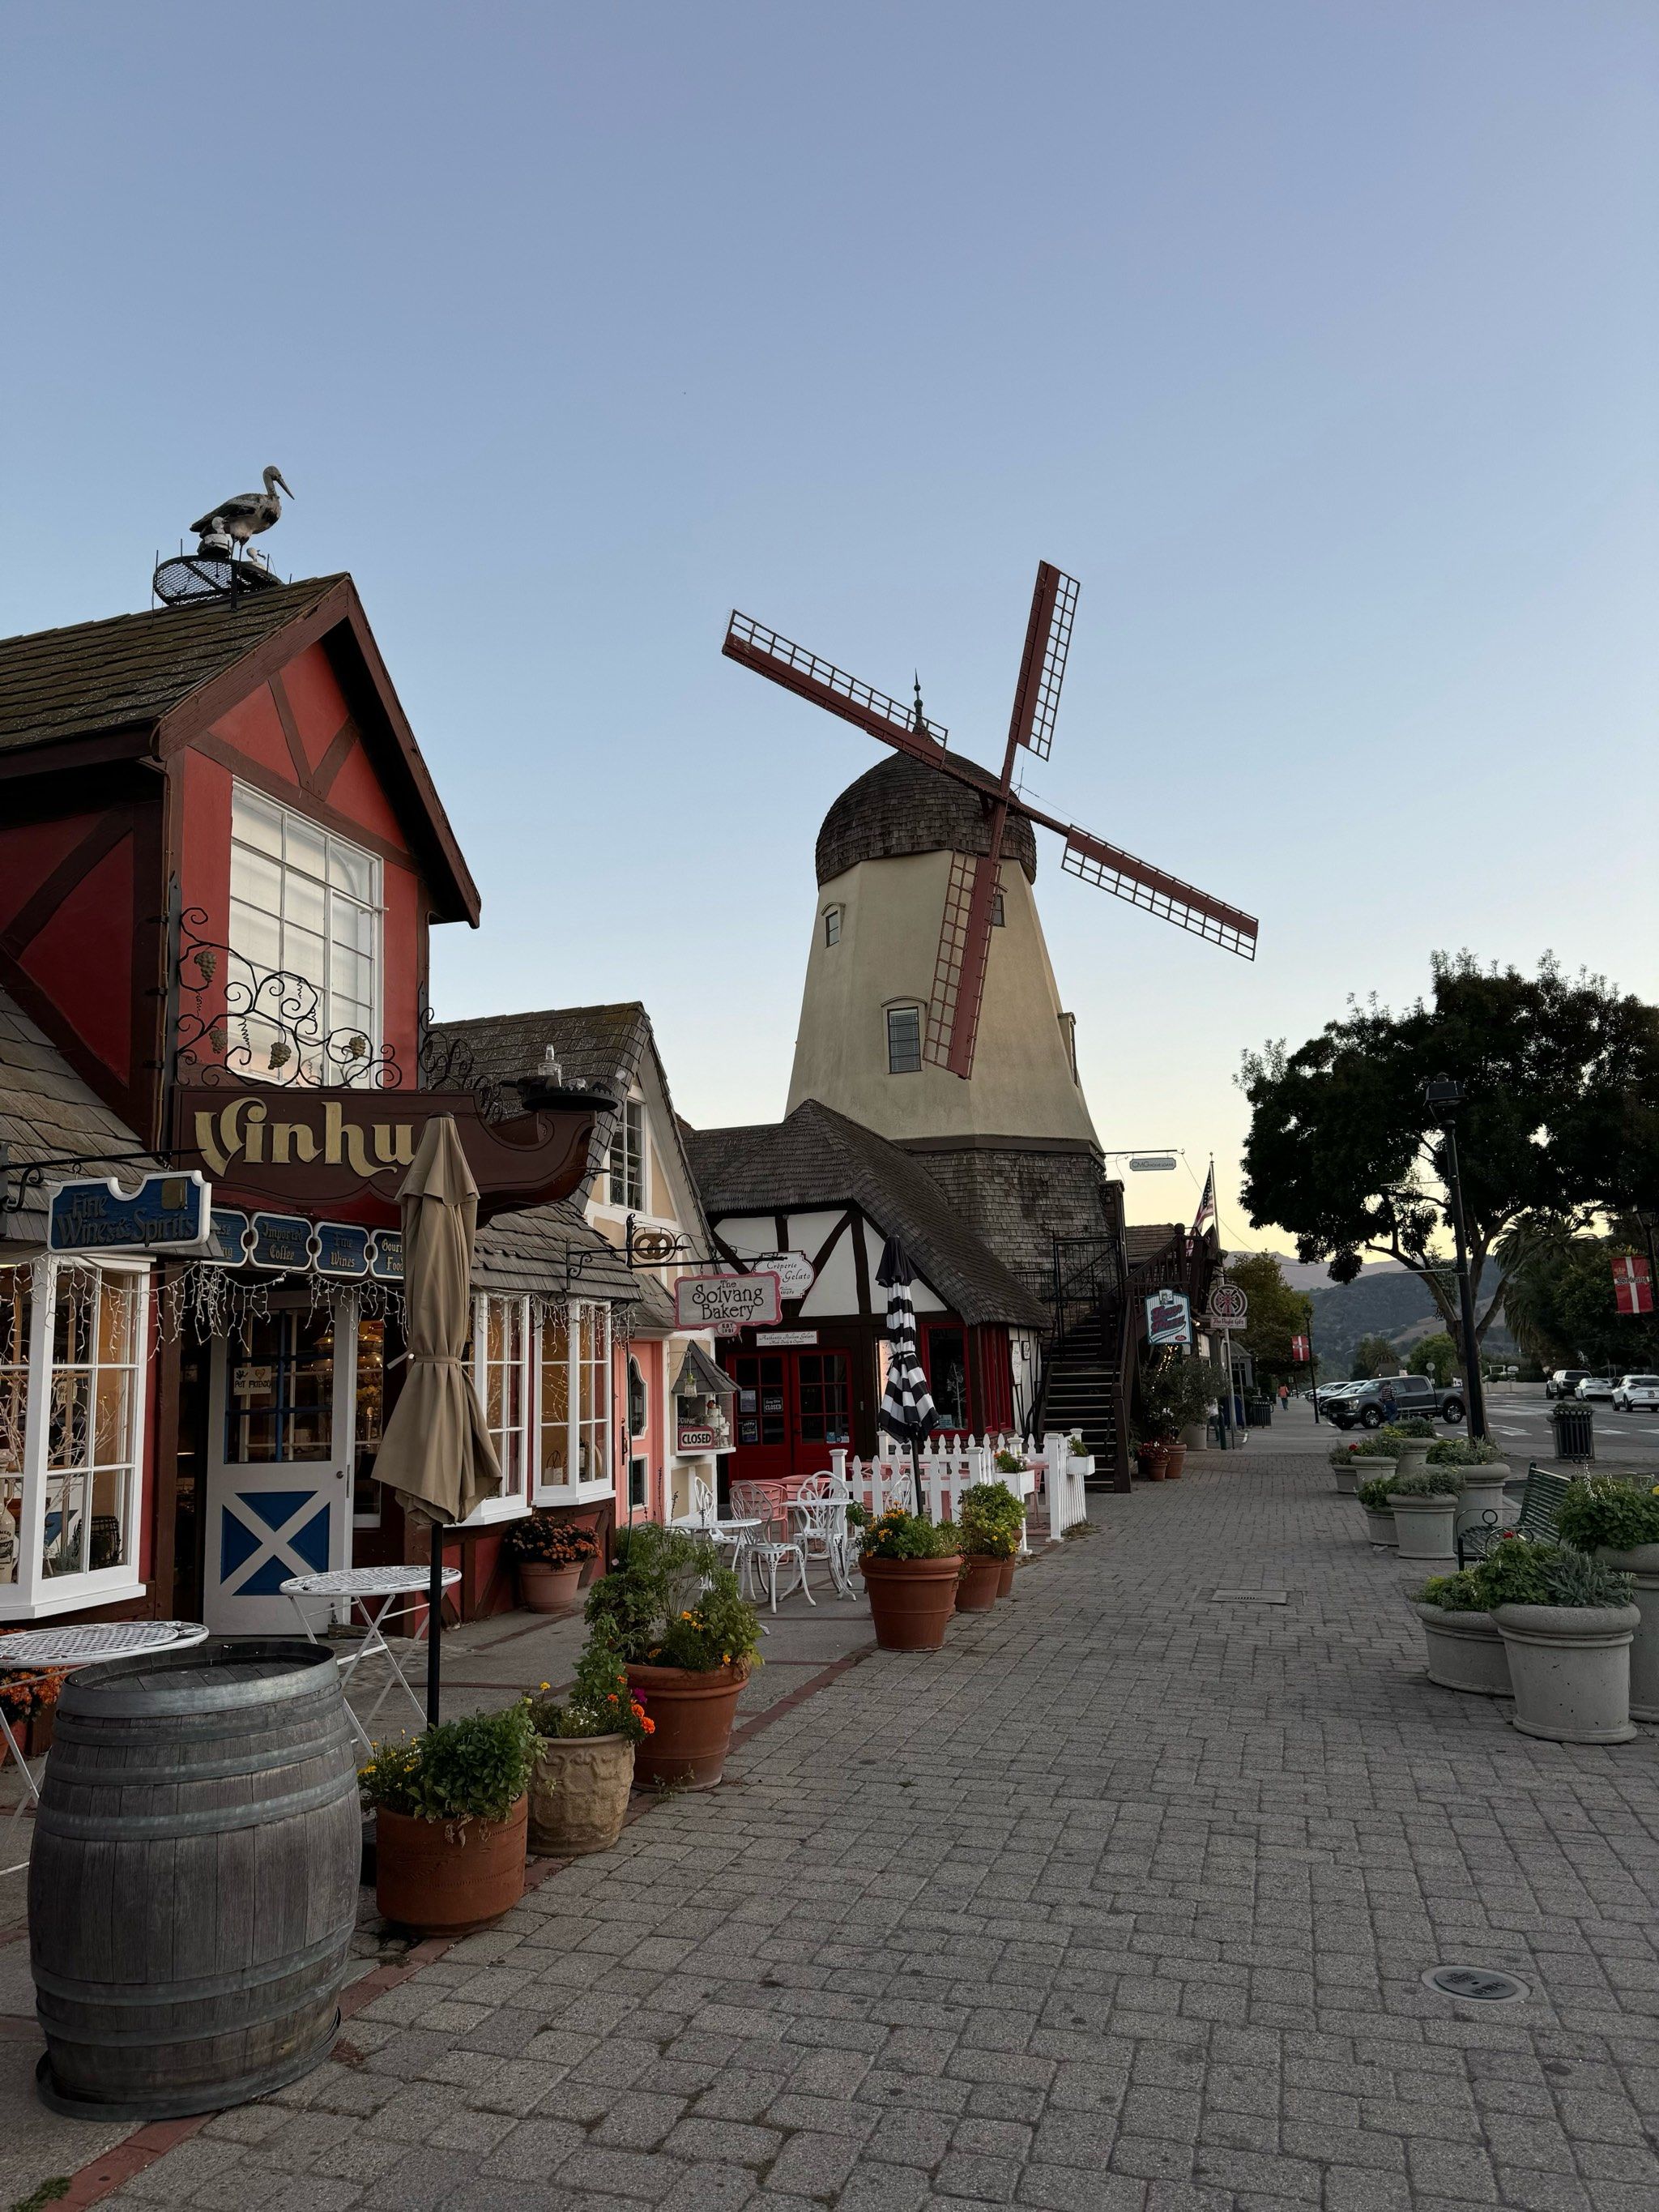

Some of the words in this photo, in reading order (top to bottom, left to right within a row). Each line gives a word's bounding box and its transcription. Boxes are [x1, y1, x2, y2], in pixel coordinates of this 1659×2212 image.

[194, 1096, 416, 1177] Vinhu
[72, 1193, 108, 1219] Fine
[57, 1215, 115, 1245] Wines
[130, 1207, 195, 1247] Spirits
[262, 1222, 304, 1242] Imported
[334, 1233, 352, 1248] Fine
[382, 1238, 403, 1253] Gour
[269, 1245, 295, 1261] Coffee
[331, 1252, 355, 1267] Wines
[720, 1280, 737, 1288] The
[783, 1269, 811, 1283] Gelato
[692, 1283, 764, 1307] Solvang
[702, 1303, 755, 1321] Bakery
[682, 1433, 711, 1444] CLOSED
